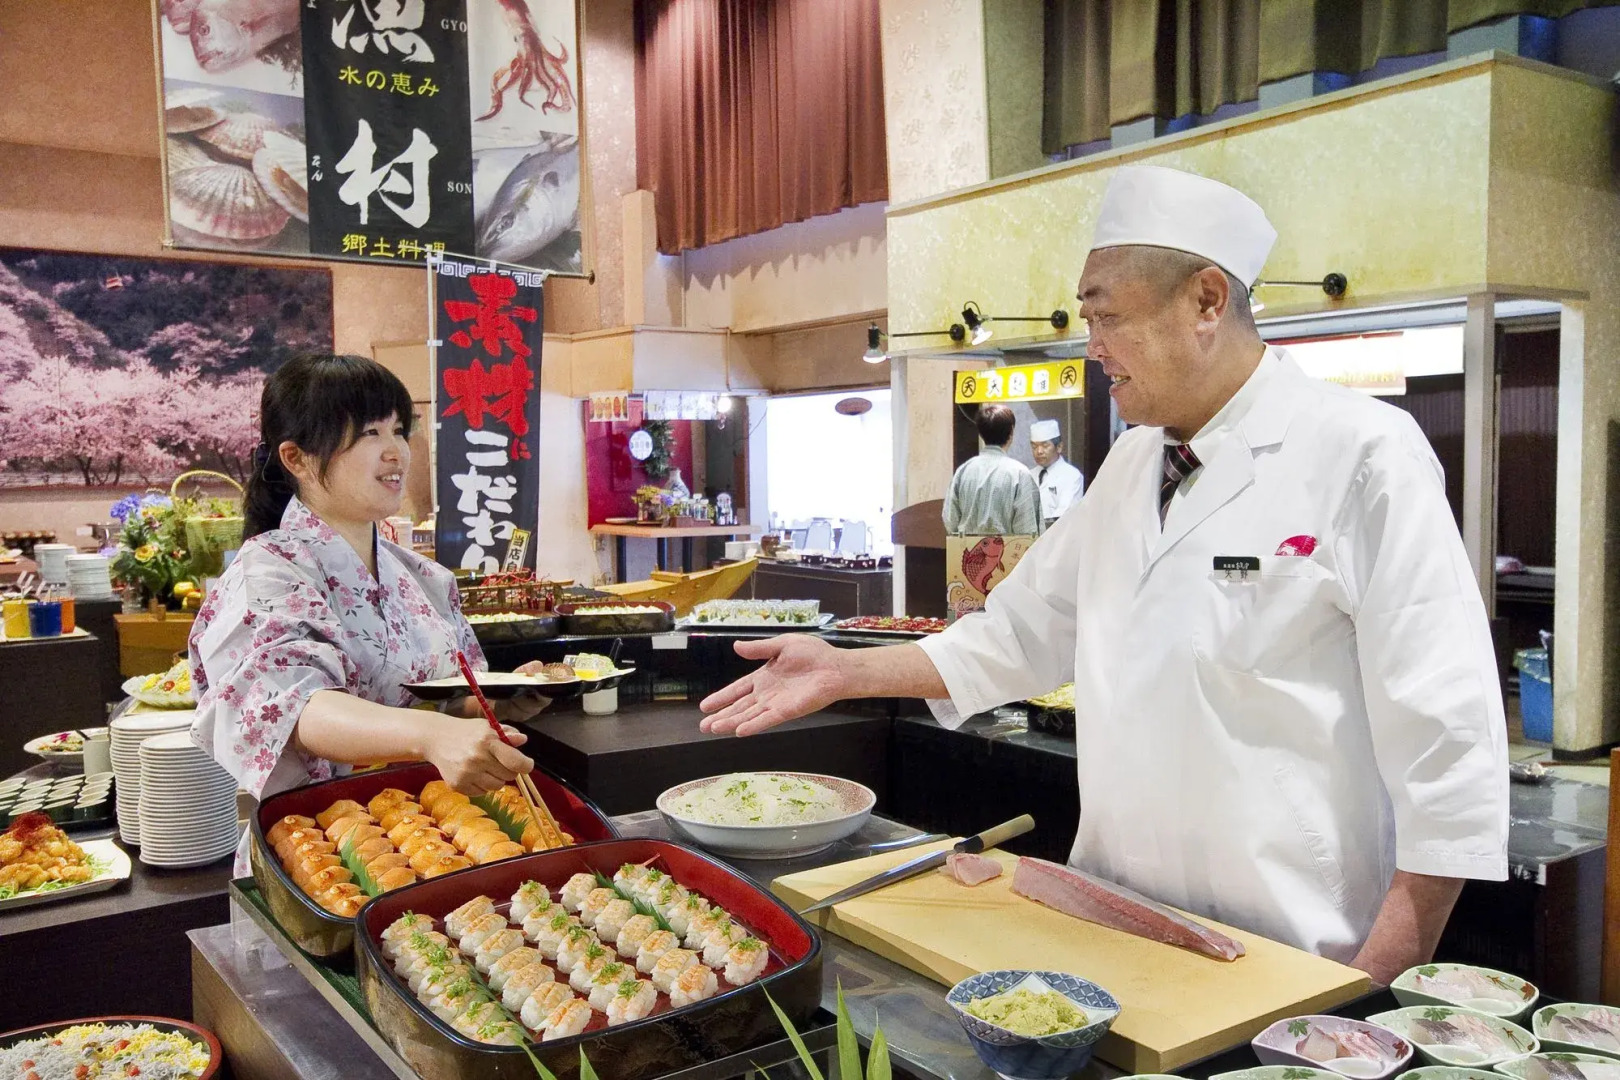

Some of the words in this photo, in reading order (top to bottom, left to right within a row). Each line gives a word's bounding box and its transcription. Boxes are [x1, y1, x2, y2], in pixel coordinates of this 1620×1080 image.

[440, 19, 468, 33] GYO
[338, 66, 440, 97] 水の恵み
[311, 155, 323, 182] そん
[335, 118, 439, 229] 村
[447, 181, 472, 194] SON
